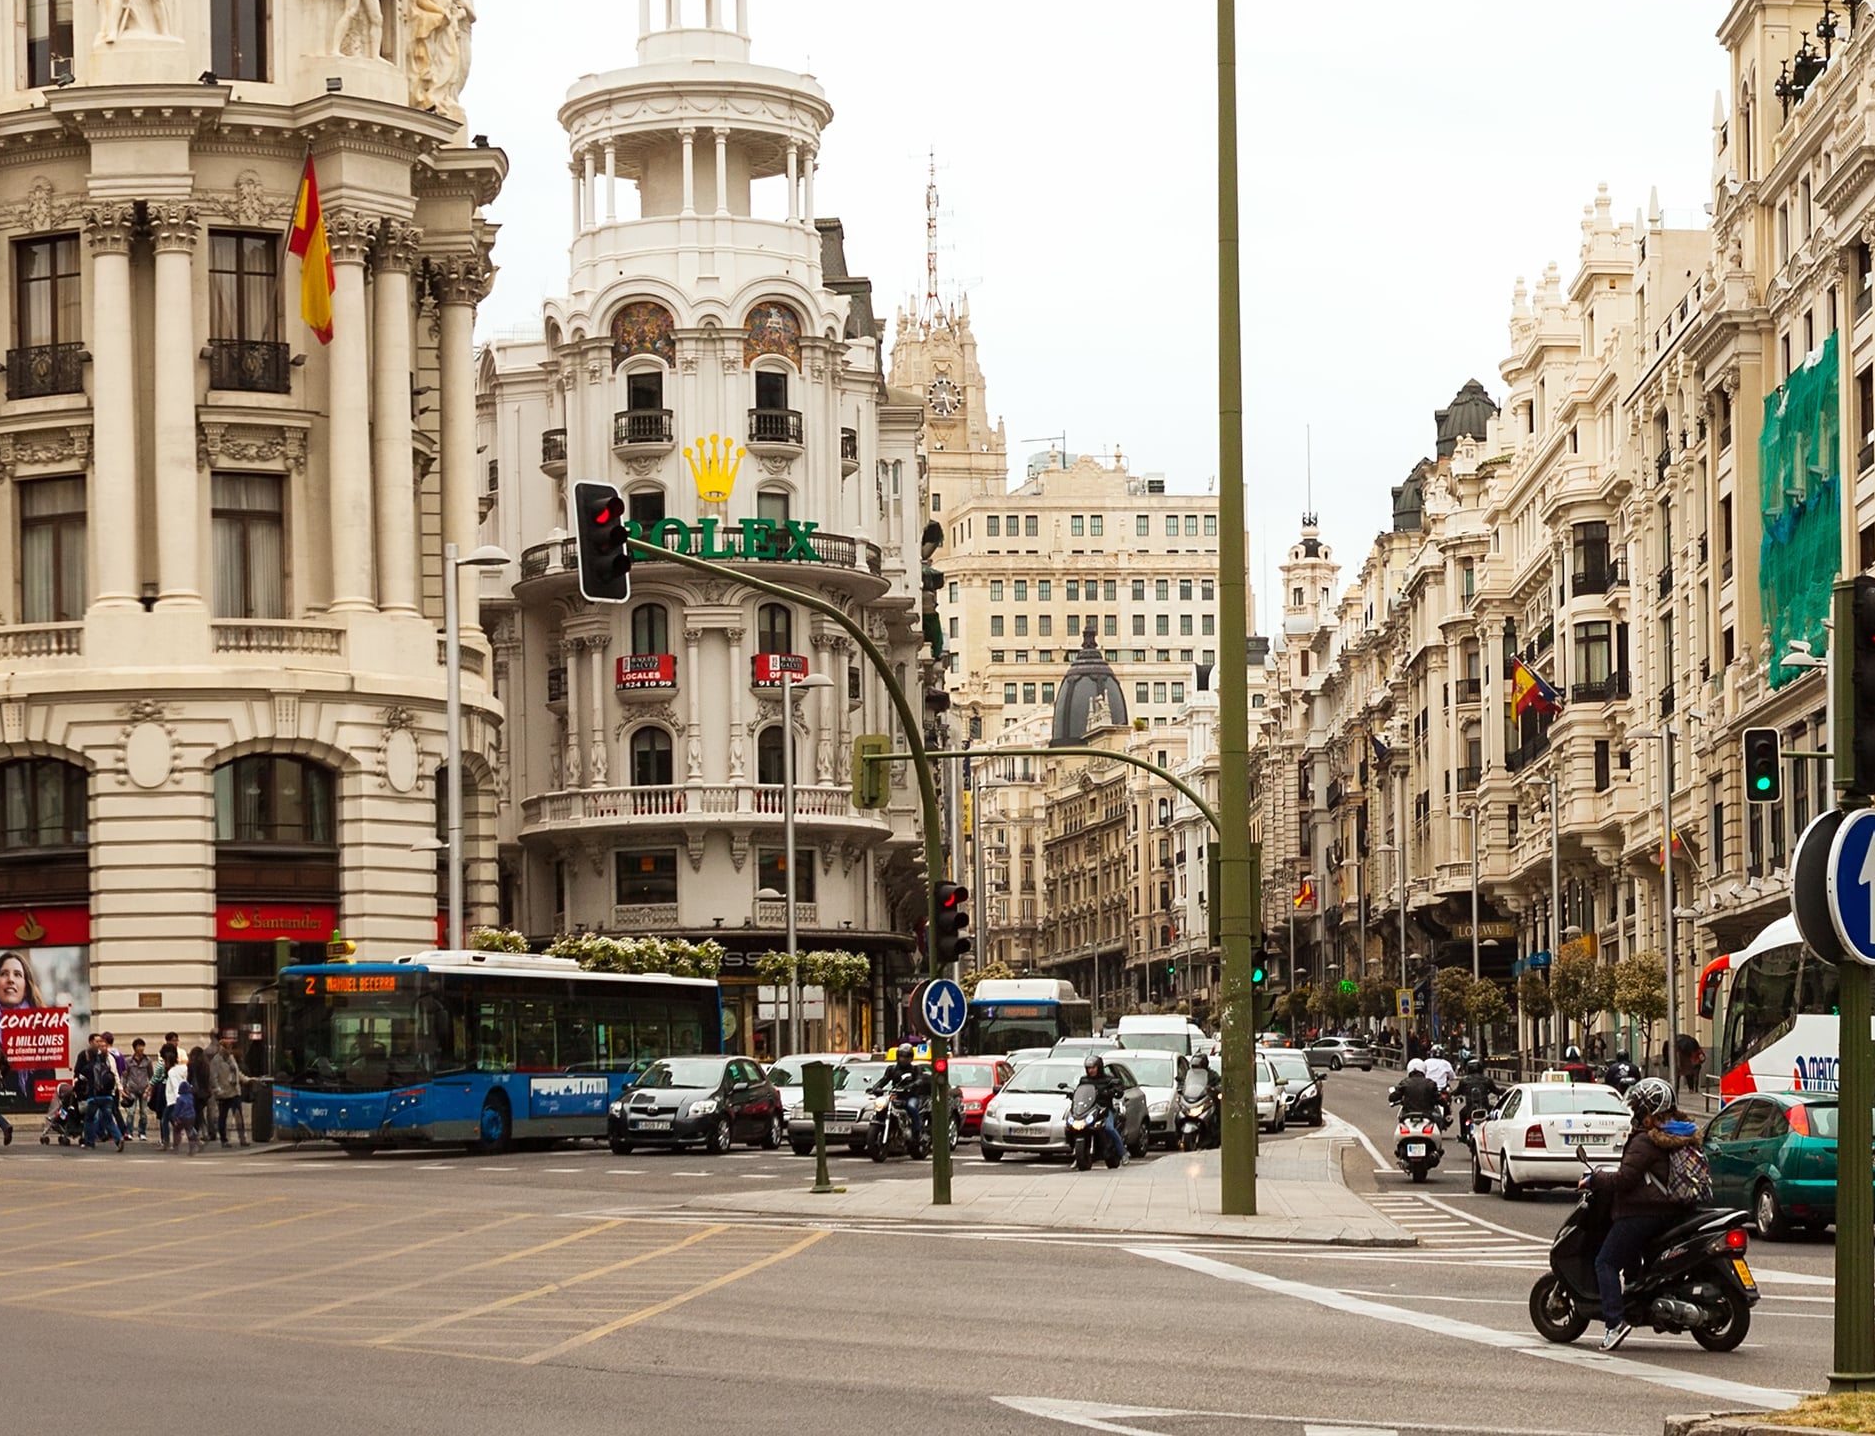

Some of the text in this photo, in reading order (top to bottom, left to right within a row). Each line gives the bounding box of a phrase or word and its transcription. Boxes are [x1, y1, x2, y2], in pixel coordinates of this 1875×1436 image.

[622, 672, 661, 680] LOCALES
[769, 672, 805, 680] OFNAS
[253, 915, 323, 930] Santander
[1458, 924, 1506, 937] LOEWE
[305, 976, 395, 995] 2 MANUEL BECERRA
[0, 1012, 74, 1030] CONFIAR
[7, 1034, 65, 1047] 4 MILLONES
[15, 1047, 37, 1055] clientes
[45, 1048, 64, 1056] pagan
